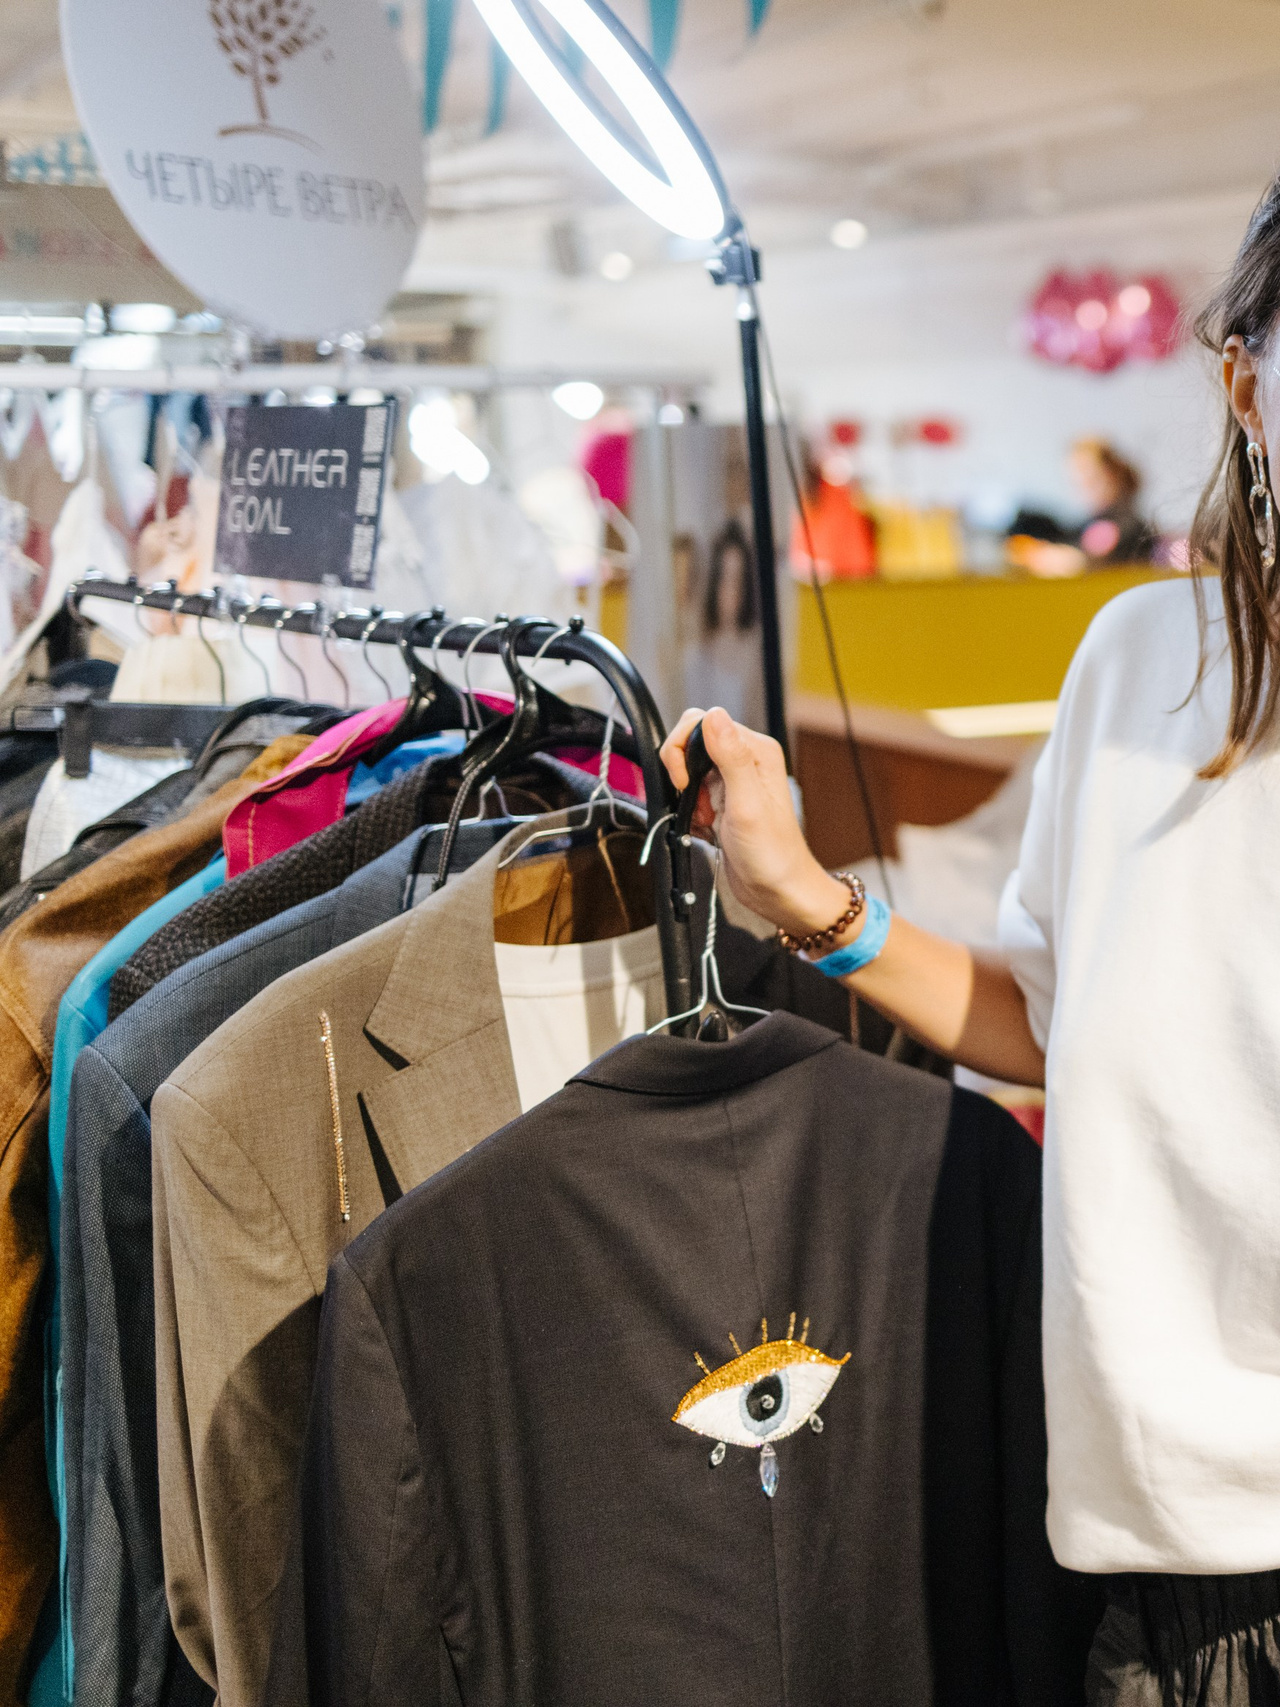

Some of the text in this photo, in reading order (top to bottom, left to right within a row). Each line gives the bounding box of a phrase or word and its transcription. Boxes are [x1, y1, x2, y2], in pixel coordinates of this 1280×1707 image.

[125, 149, 416, 233] ЧЕТЫРЕ ВЕТРА
[230, 447, 350, 488] LEATHER
[227, 494, 292, 535] GOAL
